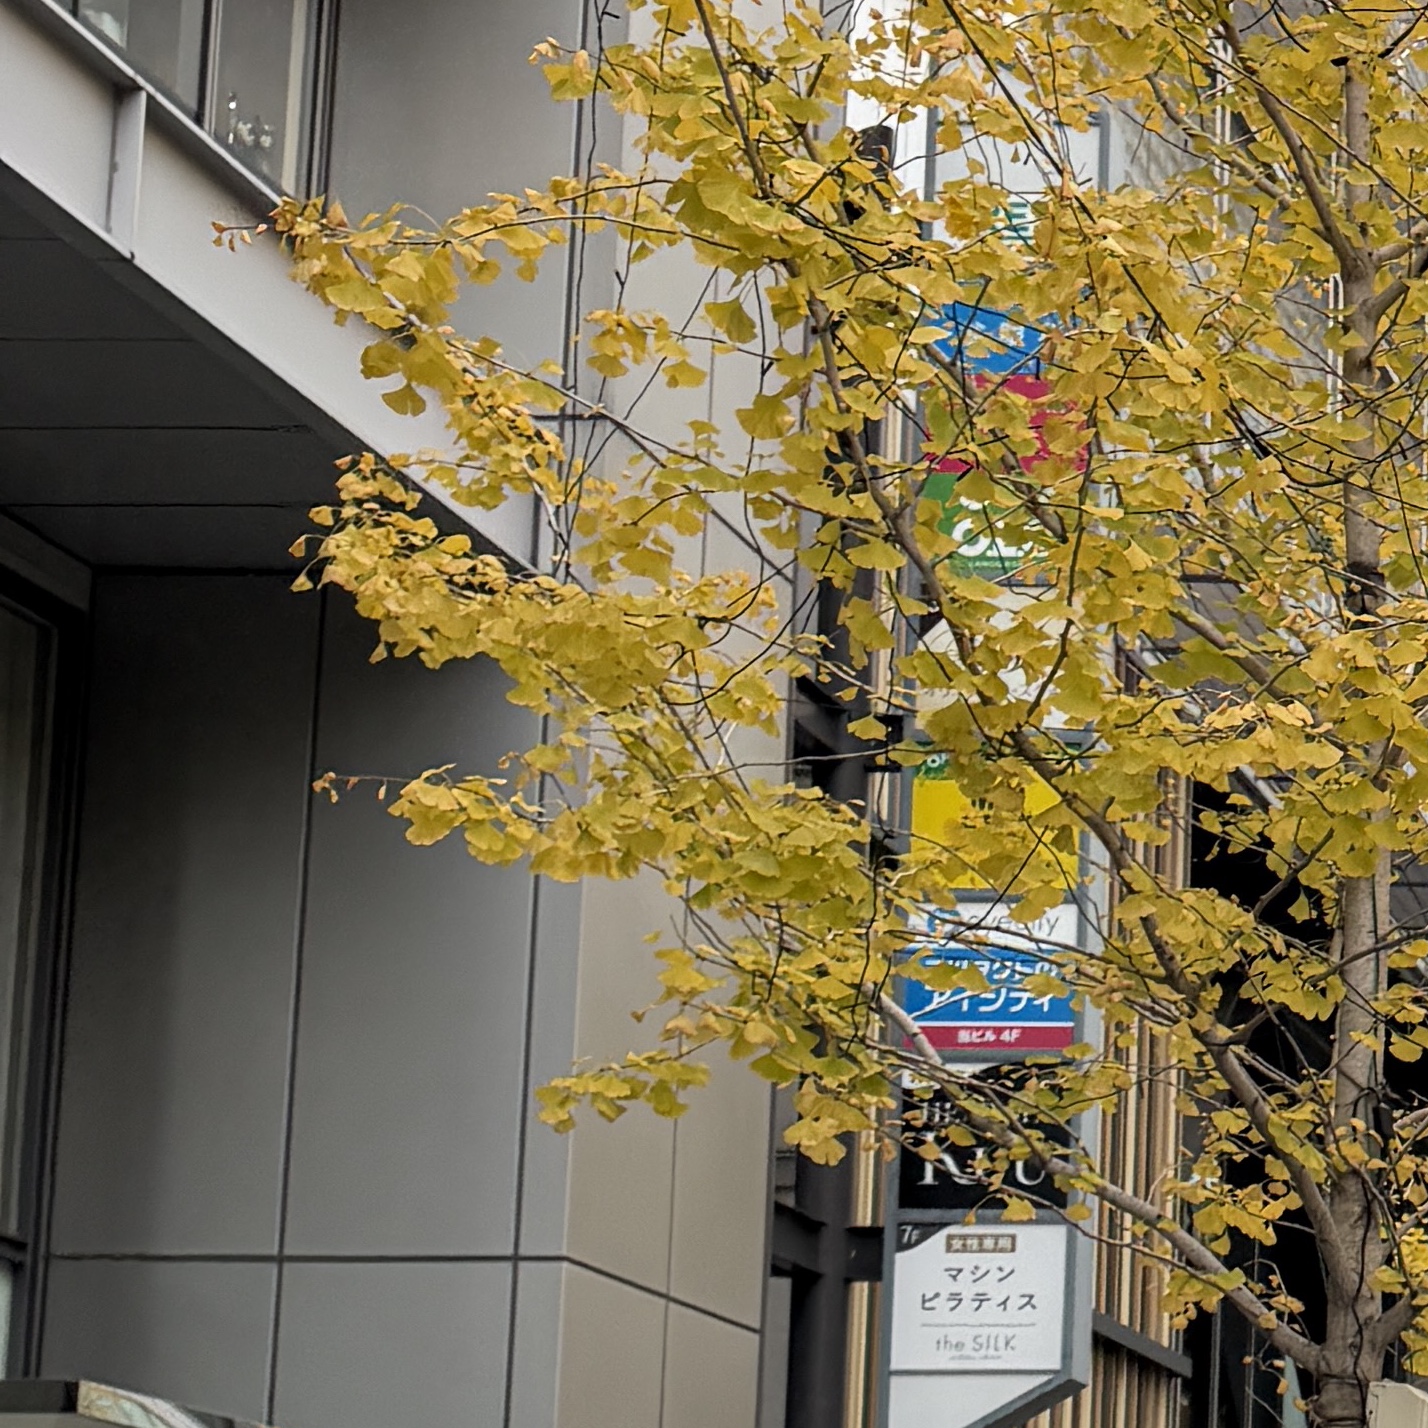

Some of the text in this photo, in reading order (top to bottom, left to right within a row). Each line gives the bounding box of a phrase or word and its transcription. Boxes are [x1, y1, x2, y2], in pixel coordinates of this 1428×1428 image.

[1000, 1029, 1021, 1043] 4F
[901, 1226, 920, 1244] 7F
[944, 1265, 1015, 1283] マシン
[921, 1292, 1037, 1312] ピラティス
[936, 1334, 1017, 1352] the SILK
